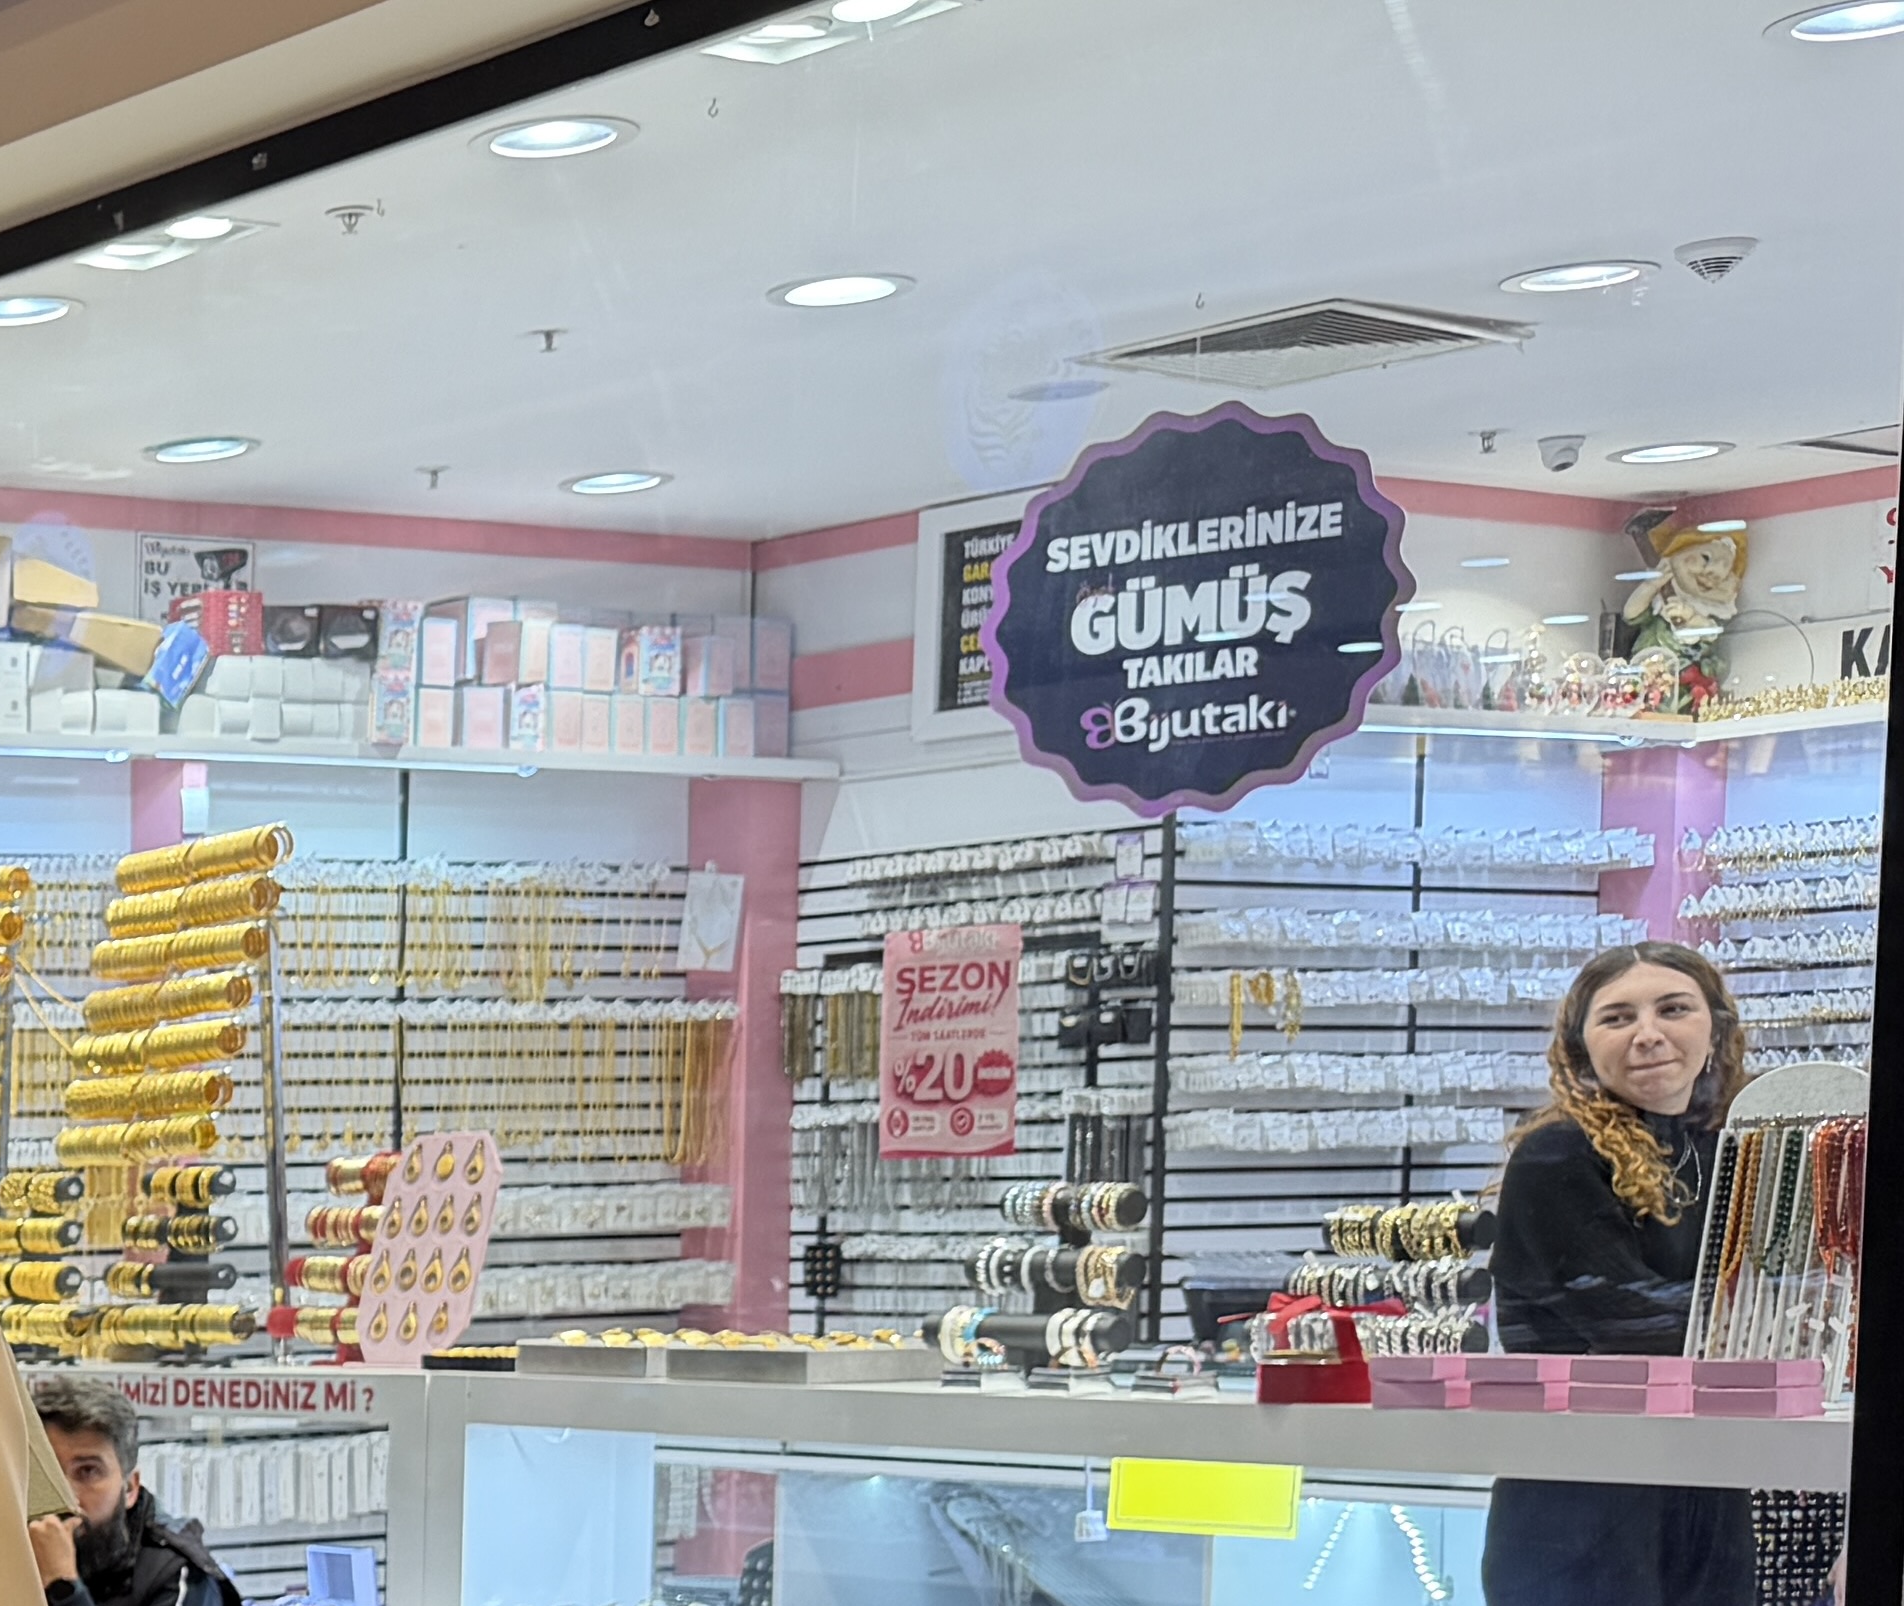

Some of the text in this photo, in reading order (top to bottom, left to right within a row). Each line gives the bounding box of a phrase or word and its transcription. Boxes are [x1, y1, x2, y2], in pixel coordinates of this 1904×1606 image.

[1045, 500, 1344, 574] SEVDİKLERİNİZE
[1070, 563, 1312, 656] GÜMÜŞ
[1122, 646, 1259, 690] TAKILAR
[895, 960, 1012, 996] SEZON
[894, 1046, 974, 1102] %20
